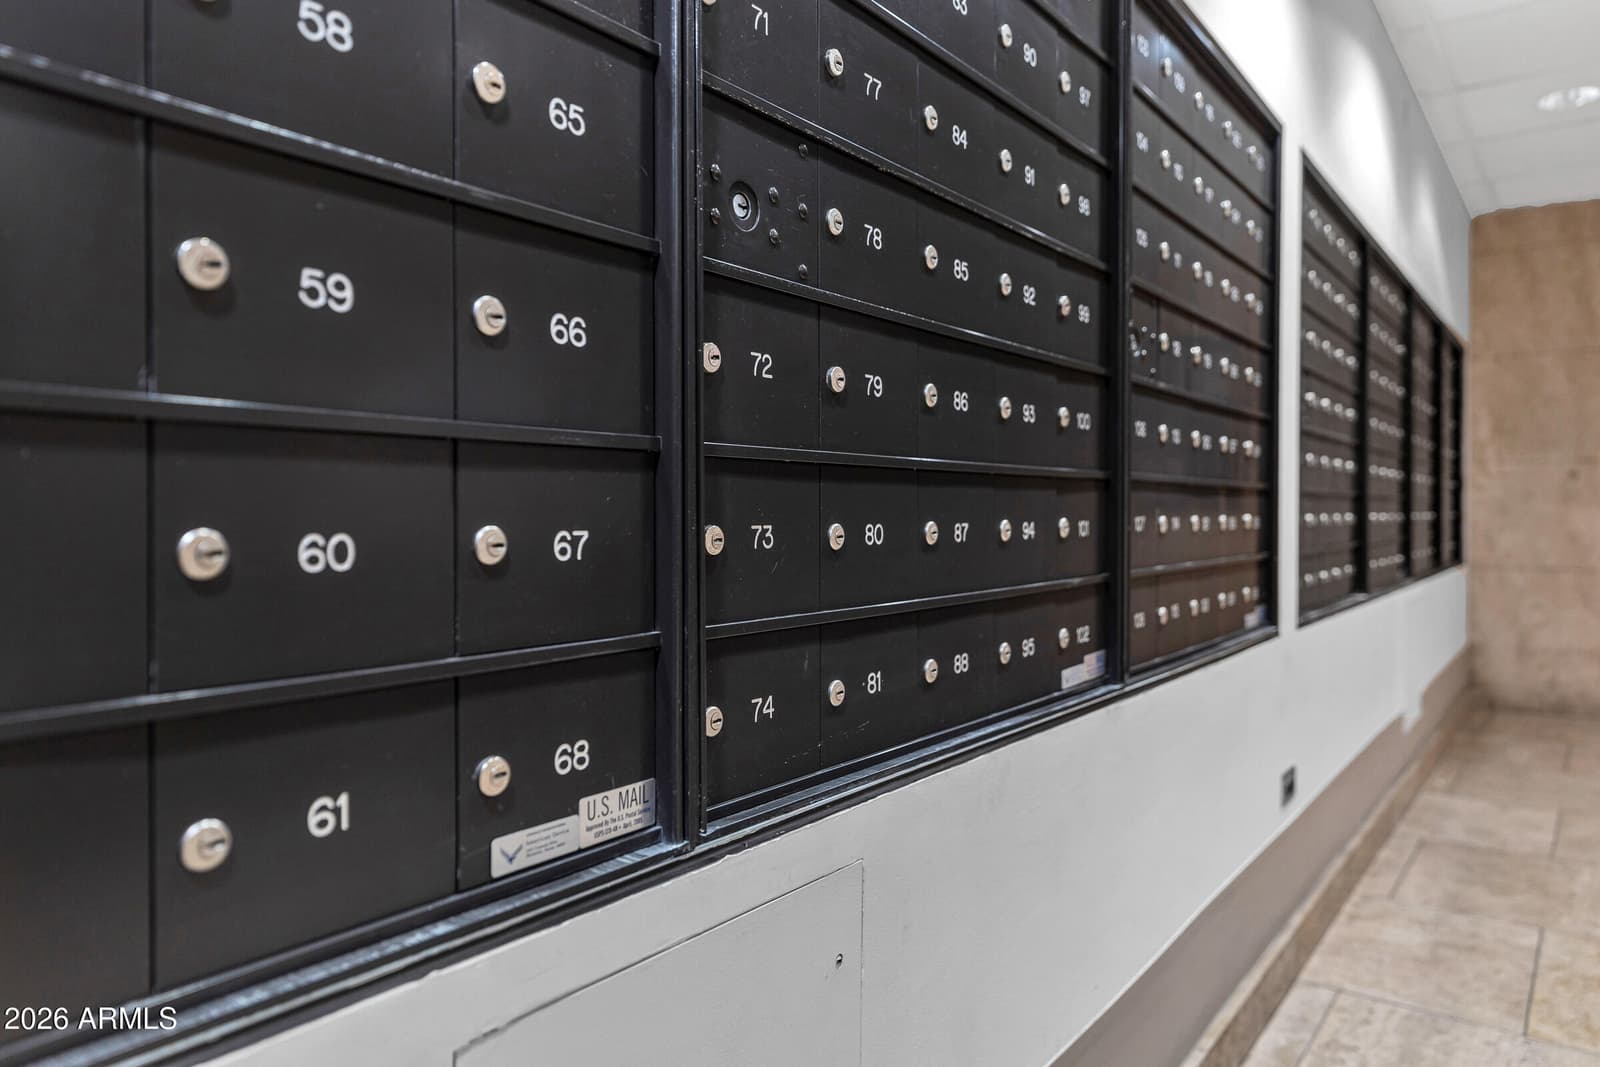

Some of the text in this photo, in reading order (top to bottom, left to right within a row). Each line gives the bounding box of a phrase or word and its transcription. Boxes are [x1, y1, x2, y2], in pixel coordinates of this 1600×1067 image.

[297, 0, 354, 52] 58
[751, 3, 769, 36] 71
[1023, 42, 1037, 68] 90
[863, 72, 882, 101] 77
[1078, 86, 1091, 107] 97
[548, 97, 586, 137] 65
[951, 124, 968, 150] 84
[1024, 165, 1035, 187] 91
[863, 223, 882, 250] 78
[953, 258, 969, 282] 85
[298, 267, 354, 313] 59
[1022, 284, 1036, 306] 92
[1078, 304, 1090, 324] 99
[549, 312, 587, 348] 66
[750, 351, 773, 379] 72
[864, 373, 883, 398] 79
[953, 390, 969, 412] 86
[1022, 403, 1036, 424] 93
[750, 524, 774, 550] 73
[864, 523, 884, 546] 80
[953, 522, 969, 543] 87
[1022, 521, 1036, 540] 94
[297, 532, 356, 574] 60
[553, 530, 589, 562] 67
[1021, 637, 1035, 658] 95
[953, 652, 969, 674] 88
[866, 670, 881, 694] 81
[751, 695, 775, 723] 74
[554, 739, 590, 776] 68
[307, 791, 350, 838] 61
[587, 783, 650, 822] U.S. MAIL
